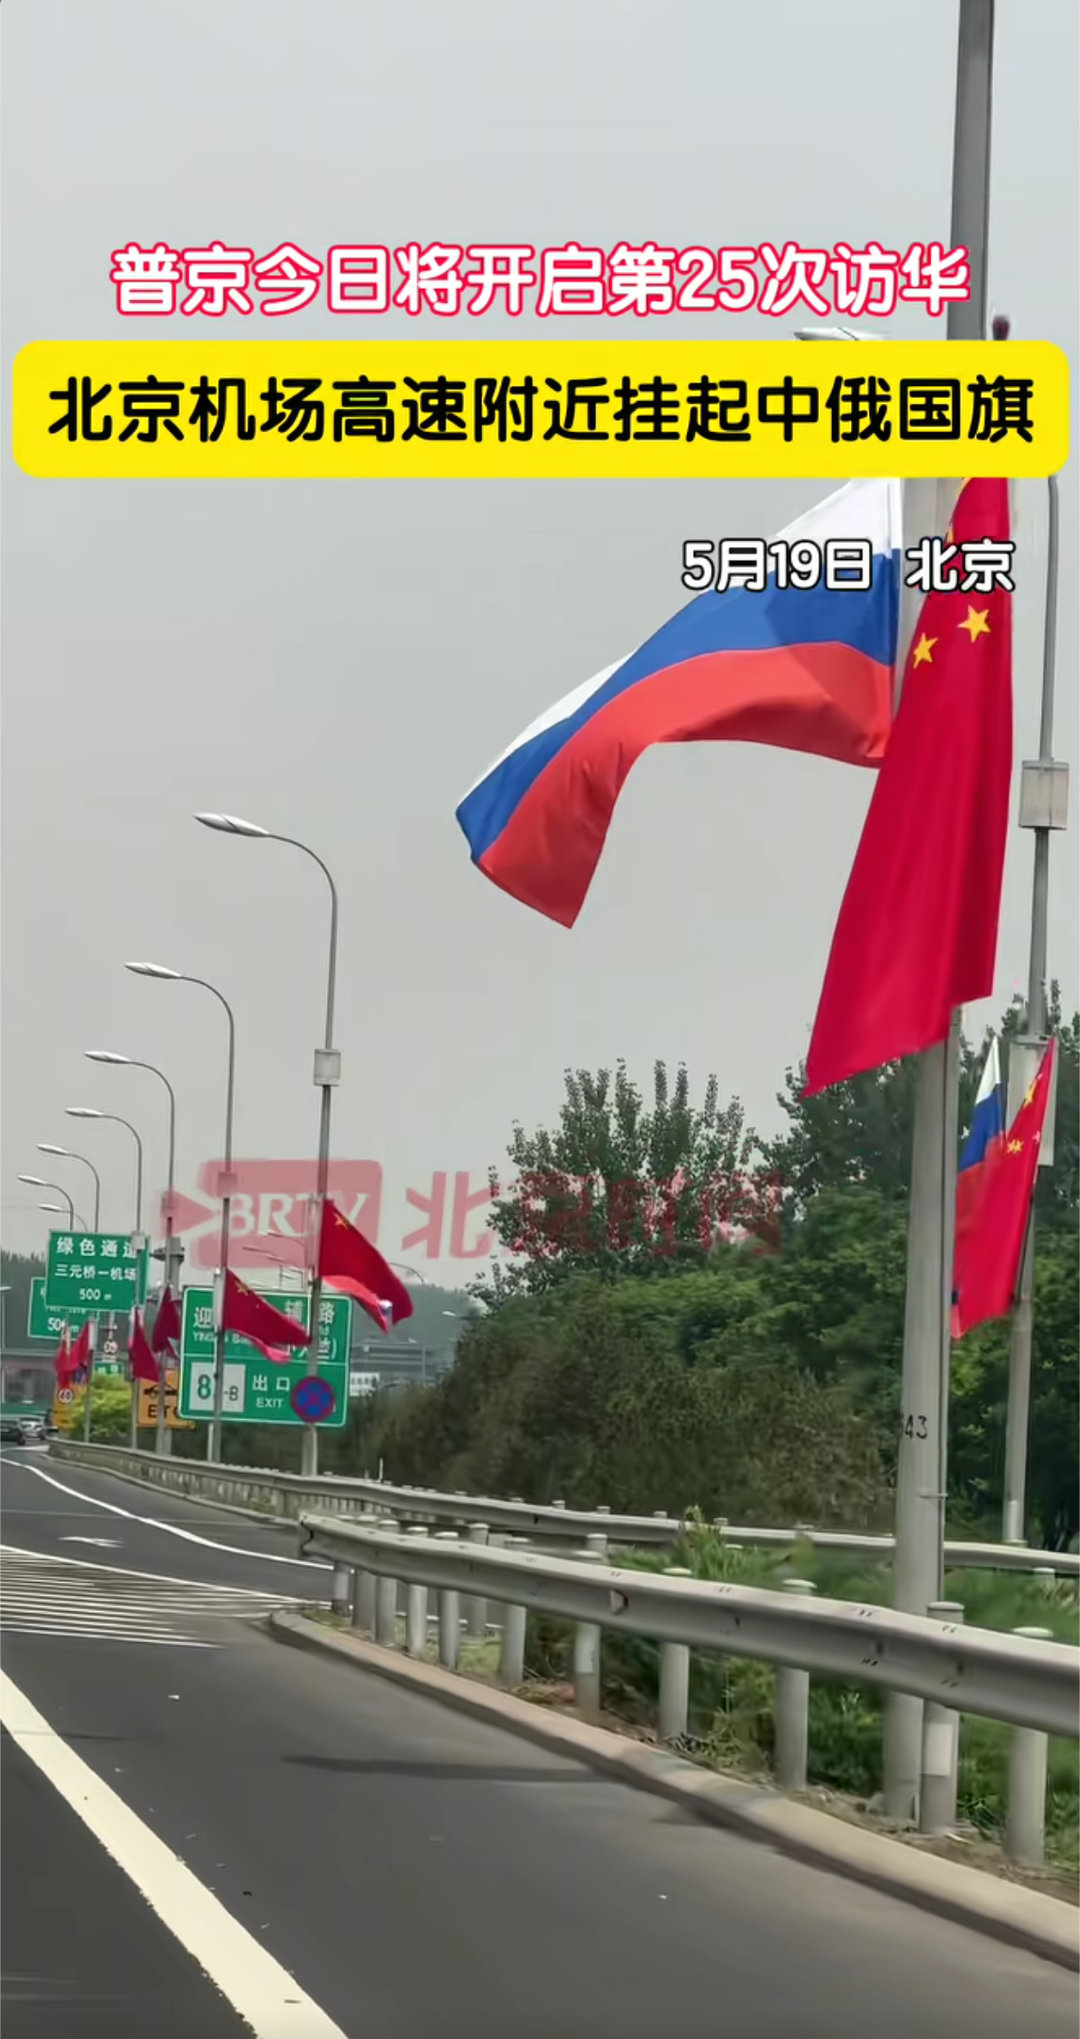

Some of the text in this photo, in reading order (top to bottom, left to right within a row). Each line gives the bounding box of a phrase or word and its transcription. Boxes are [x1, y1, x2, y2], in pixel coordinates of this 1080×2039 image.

[79, 1288, 101, 1301] 500
[253, 1374, 290, 1392] 出口
[256, 1397, 284, 1408] EXIT
